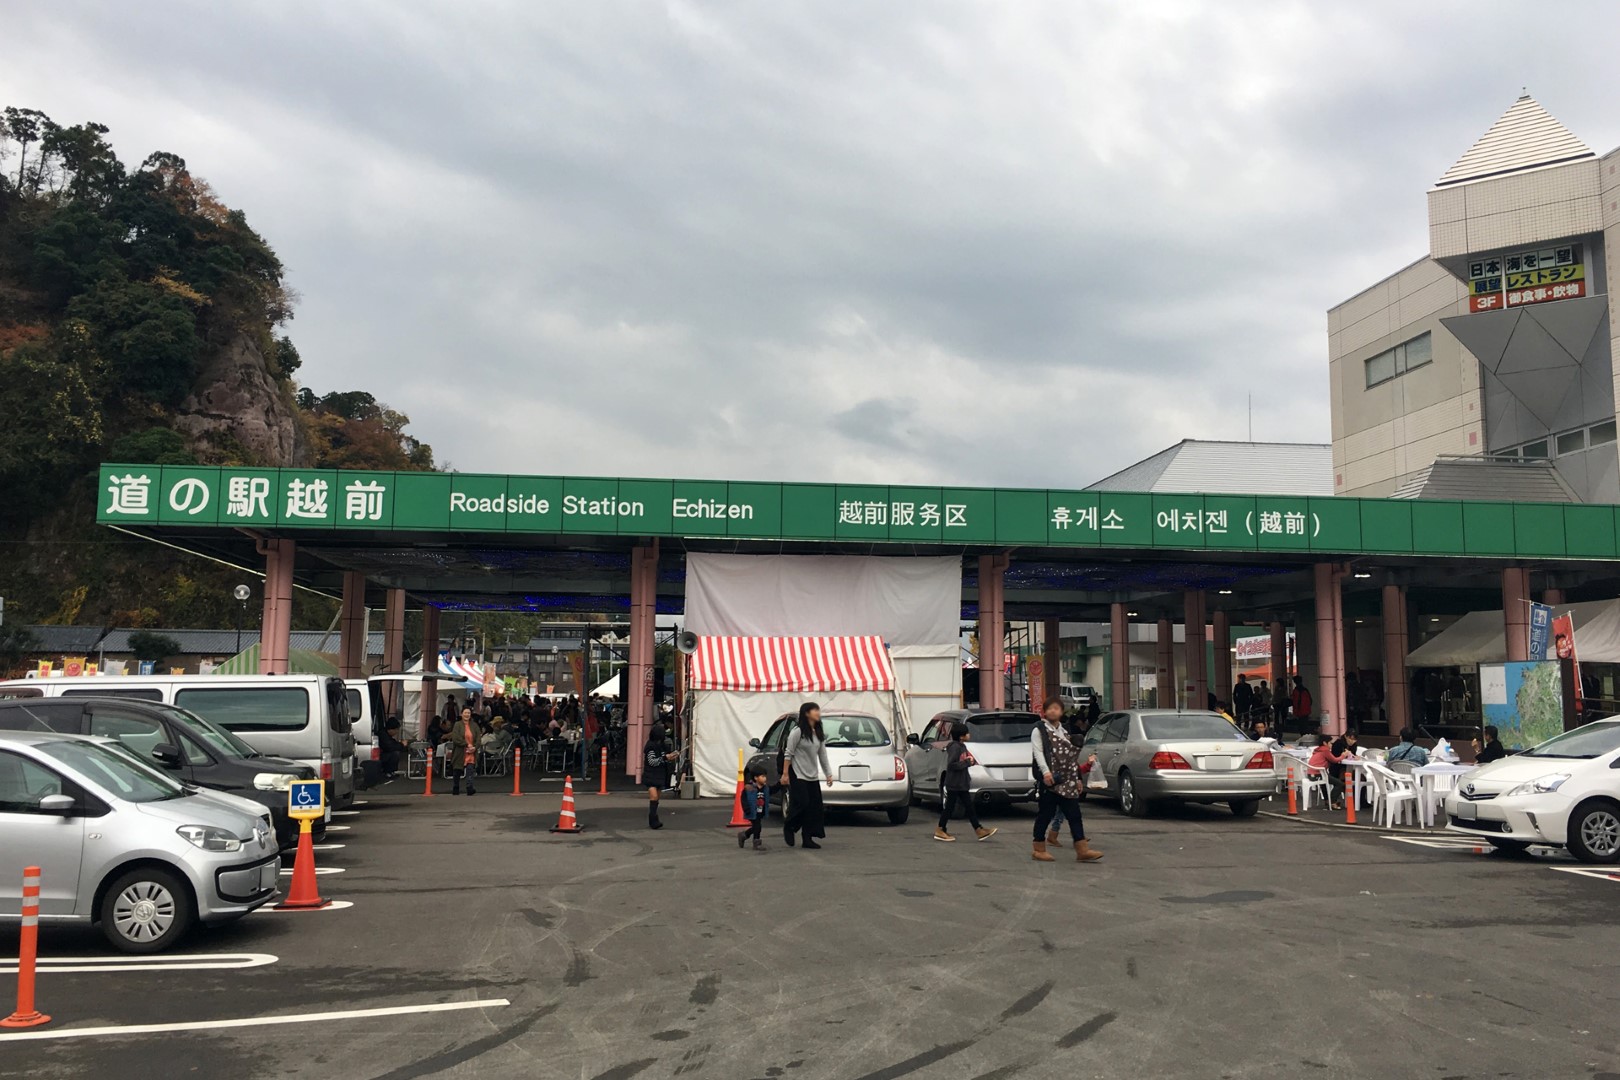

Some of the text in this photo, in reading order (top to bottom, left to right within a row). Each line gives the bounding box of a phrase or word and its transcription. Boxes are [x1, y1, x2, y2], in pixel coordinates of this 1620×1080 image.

[1470, 248, 1572, 277] 日本海を一望
[1474, 267, 1577, 293] 展望レストラン
[1476, 283, 1579, 309] 3F 御食事・飲物
[106, 474, 386, 520] 道の駅越前
[450, 492, 753, 520] Roadside Station Echizen
[839, 500, 967, 527] 越前服务区
[1050, 506, 1125, 531] 휴게소
